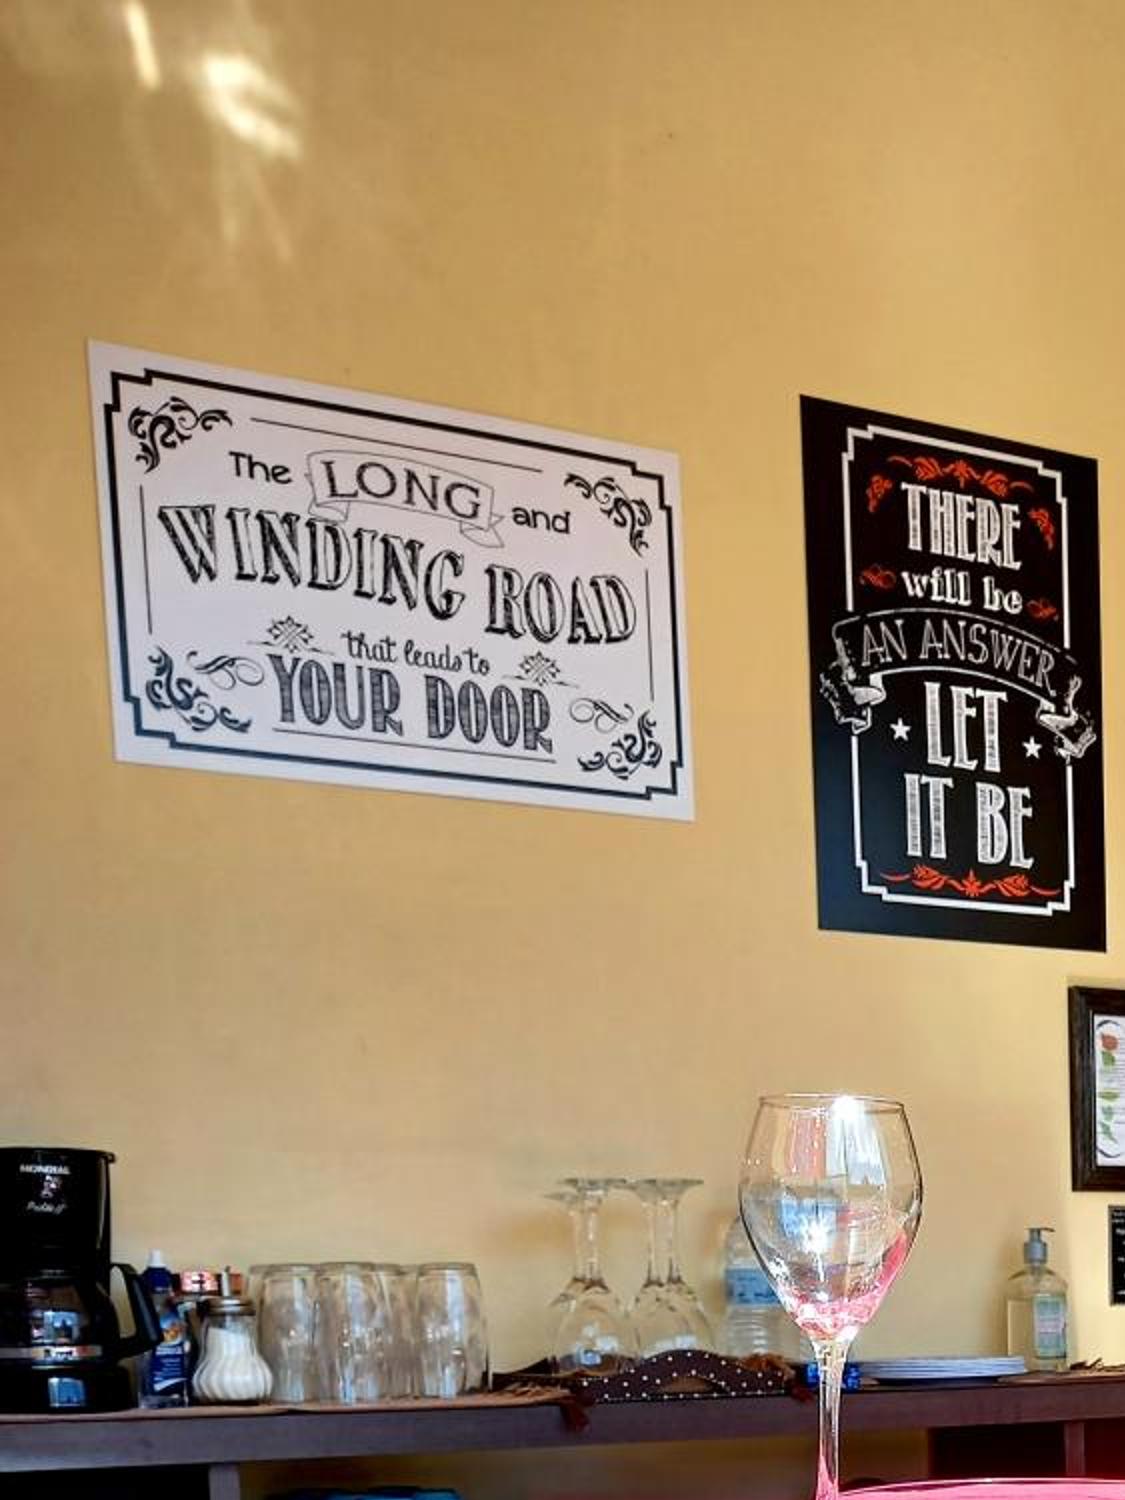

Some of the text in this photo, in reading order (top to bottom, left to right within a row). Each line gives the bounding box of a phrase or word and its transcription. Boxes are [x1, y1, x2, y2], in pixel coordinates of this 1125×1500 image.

[229, 451, 571, 534] The LONG and
[901, 482, 1022, 570] THERE
[159, 504, 637, 645] WINDING ROAD
[901, 567, 1023, 616] will be
[341, 631, 490, 677] that leads to
[861, 619, 1057, 696] AN ANSWER
[267, 652, 553, 753] YOUR DOOR
[924, 681, 1008, 774] LET
[903, 773, 1034, 870] IT BE
